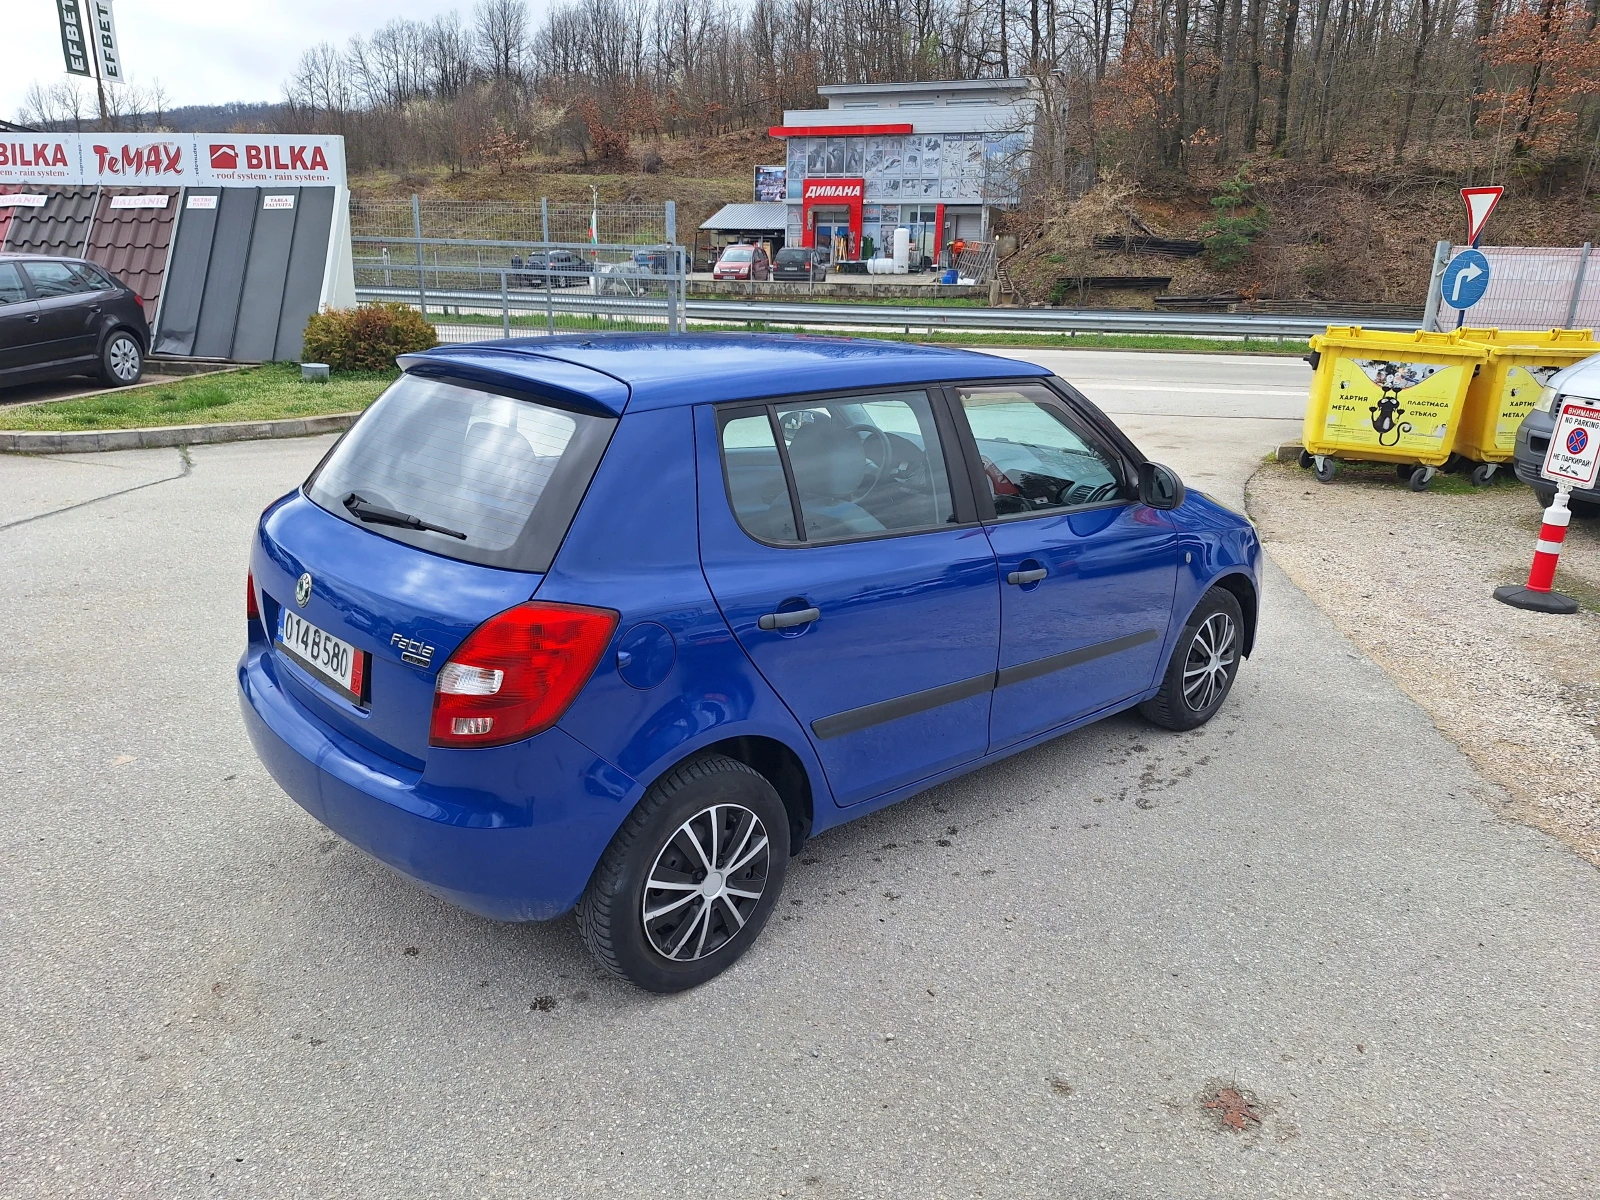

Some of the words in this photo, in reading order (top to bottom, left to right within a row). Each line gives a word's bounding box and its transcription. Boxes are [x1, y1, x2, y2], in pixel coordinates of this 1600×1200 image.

[96, 1, 118, 77] EFBET
[0, 143, 68, 166] BILKA
[92, 144, 184, 176] TeMAX
[245, 145, 329, 170] BILKA
[37, 169, 65, 178] system
[216, 171, 236, 180] roof
[237, 173, 267, 183] system
[274, 172, 293, 181] rain
[294, 173, 325, 182] system
[805, 185, 861, 199] ДИМАНА
[1339, 394, 1369, 402] ХАРТИЯ
[1407, 400, 1449, 408] ПЛАСТМАСА
[1332, 404, 1356, 412] МЕТАЛ
[1564, 416, 1574, 424] NO
[1553, 453, 1561, 461] НЕ
[1560, 455, 1592, 468] ПАРКИРАЙ!
[390, 632, 435, 658] Fabia
